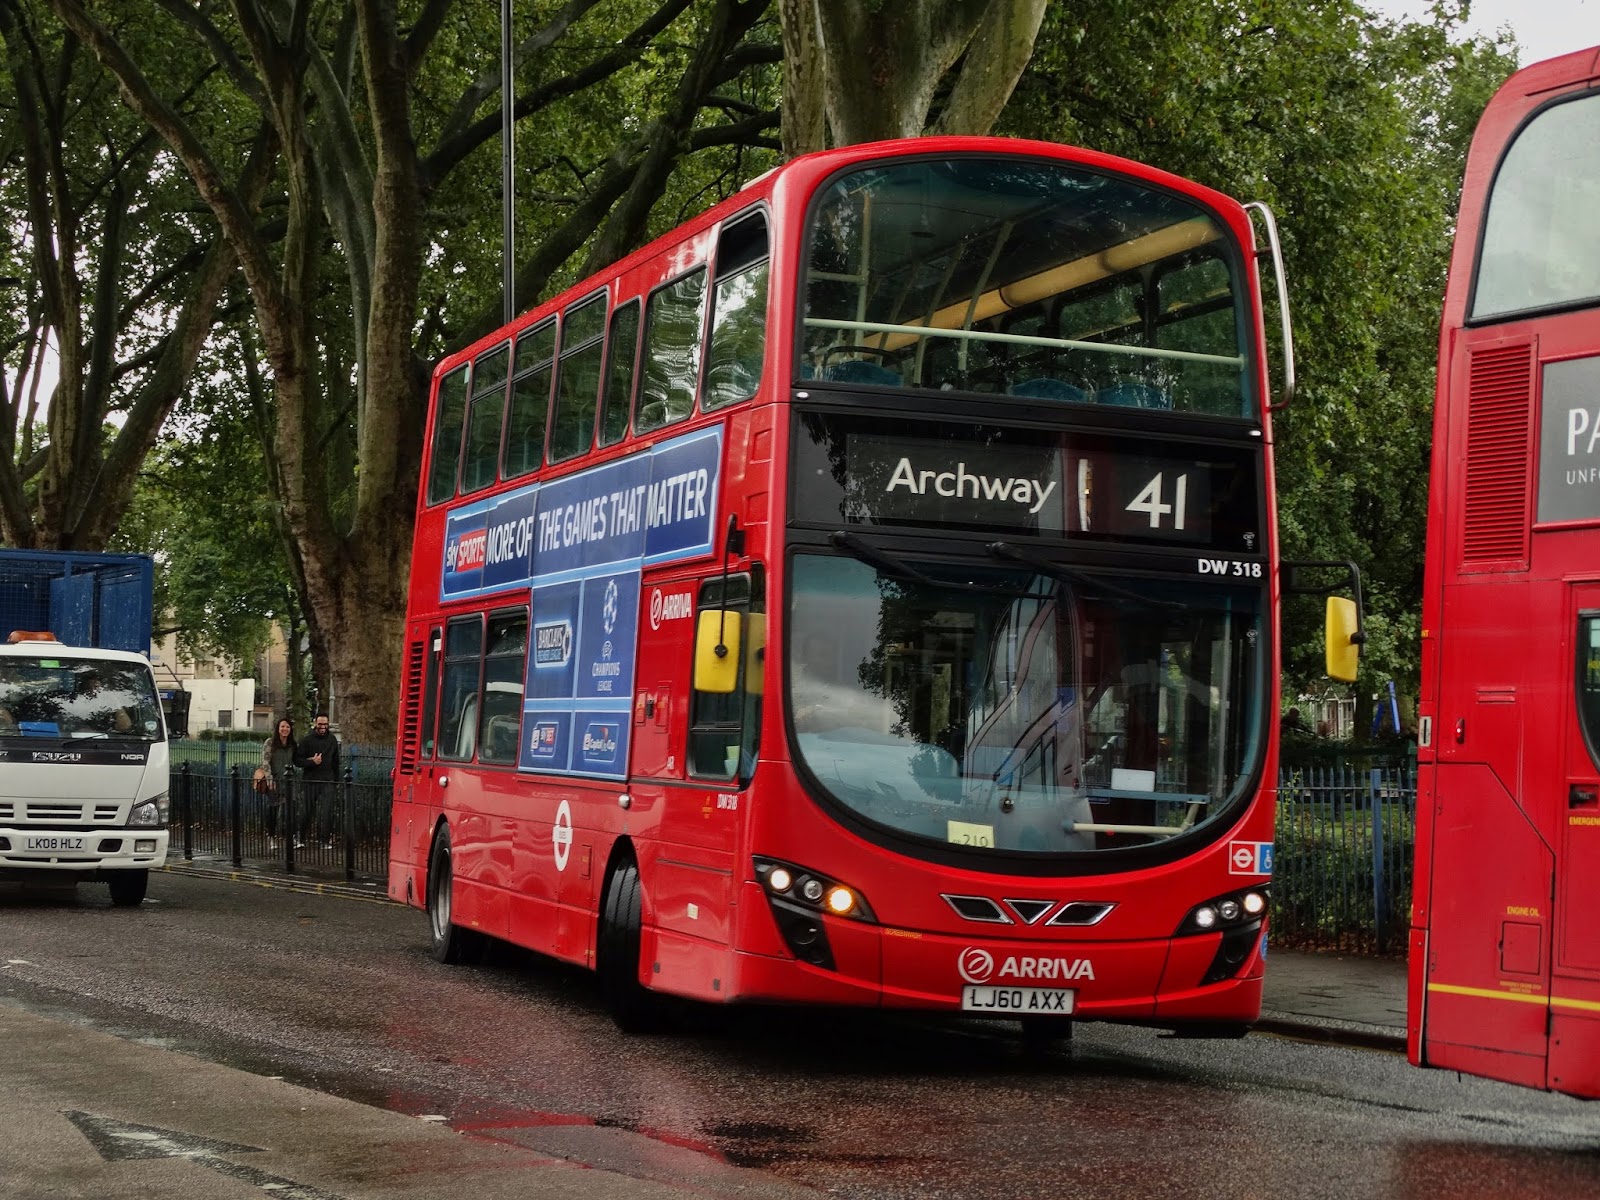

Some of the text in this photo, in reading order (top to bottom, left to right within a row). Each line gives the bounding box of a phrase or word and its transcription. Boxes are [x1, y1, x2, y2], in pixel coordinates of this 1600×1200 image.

[885, 457, 1056, 514] Archway
[1566, 467, 1600, 485] UNF
[1124, 471, 1187, 530] 41
[446, 468, 708, 571] sky SPORTS MORE OF THE GAMES THAT MATTER
[1198, 558, 1262, 578] DW 318
[661, 592, 692, 621] ARRIVA
[32, 751, 82, 762] ISUZU
[28, 838, 83, 849] LK08 HLZ
[1507, 906, 1540, 917] ENGINE OIL
[998, 956, 1096, 981] ARRIVA
[970, 989, 1066, 1010] LJ60 AXX
